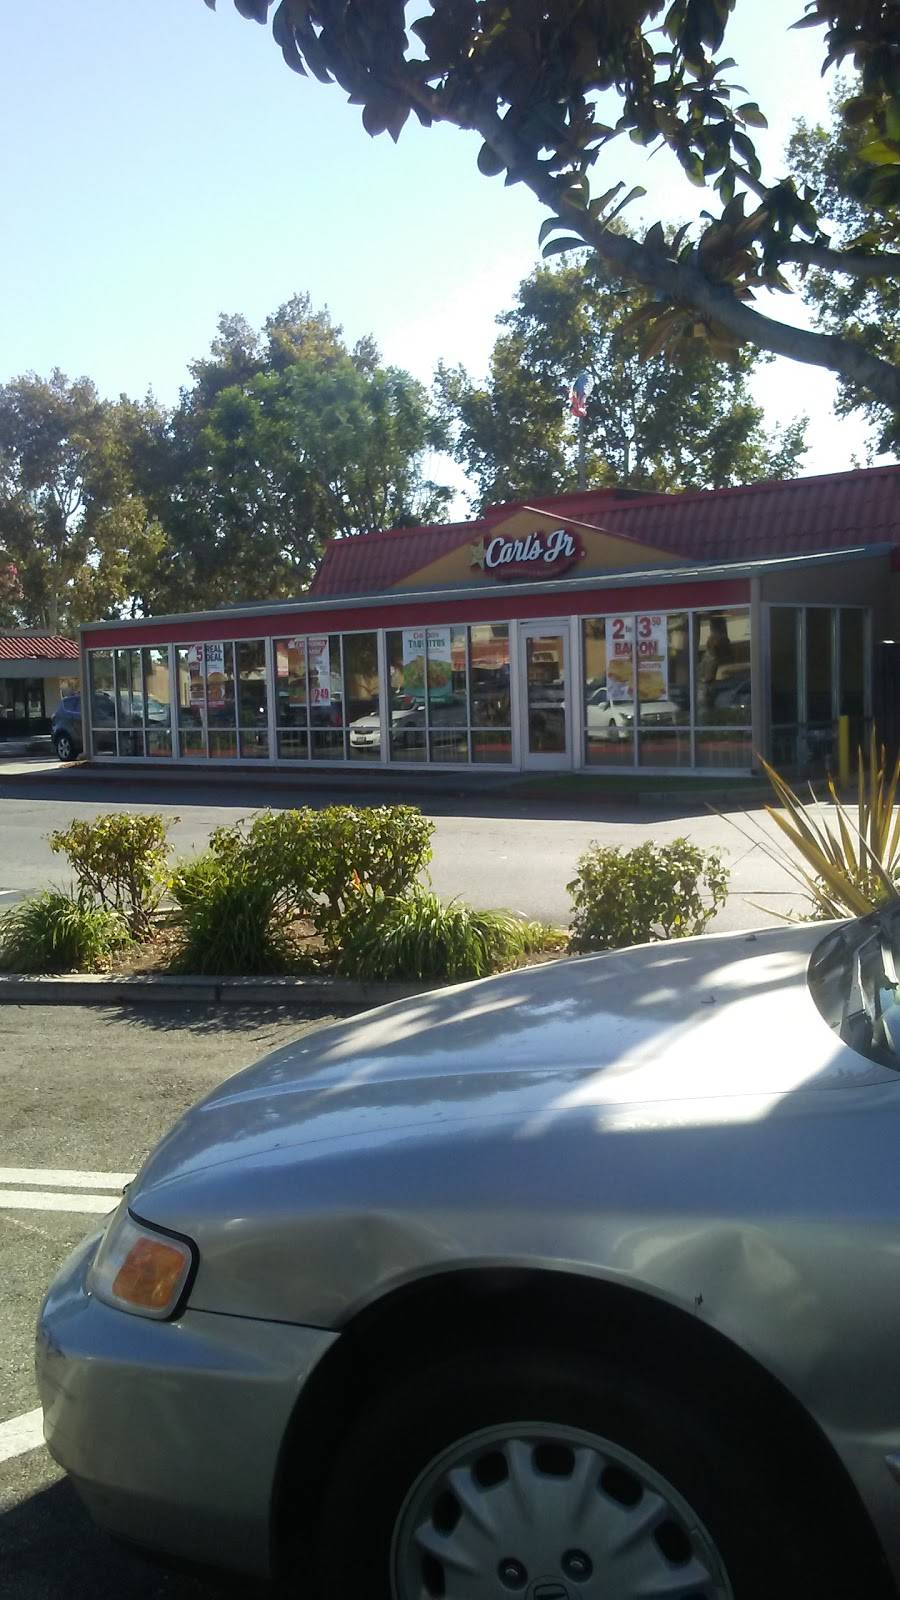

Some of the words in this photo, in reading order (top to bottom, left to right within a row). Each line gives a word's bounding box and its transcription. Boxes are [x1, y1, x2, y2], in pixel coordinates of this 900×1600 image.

[485, 531, 544, 568] Carl's
[612, 619, 625, 640] 2
[408, 639, 446, 649] TAQITOS
[614, 640, 658, 656] BAON
